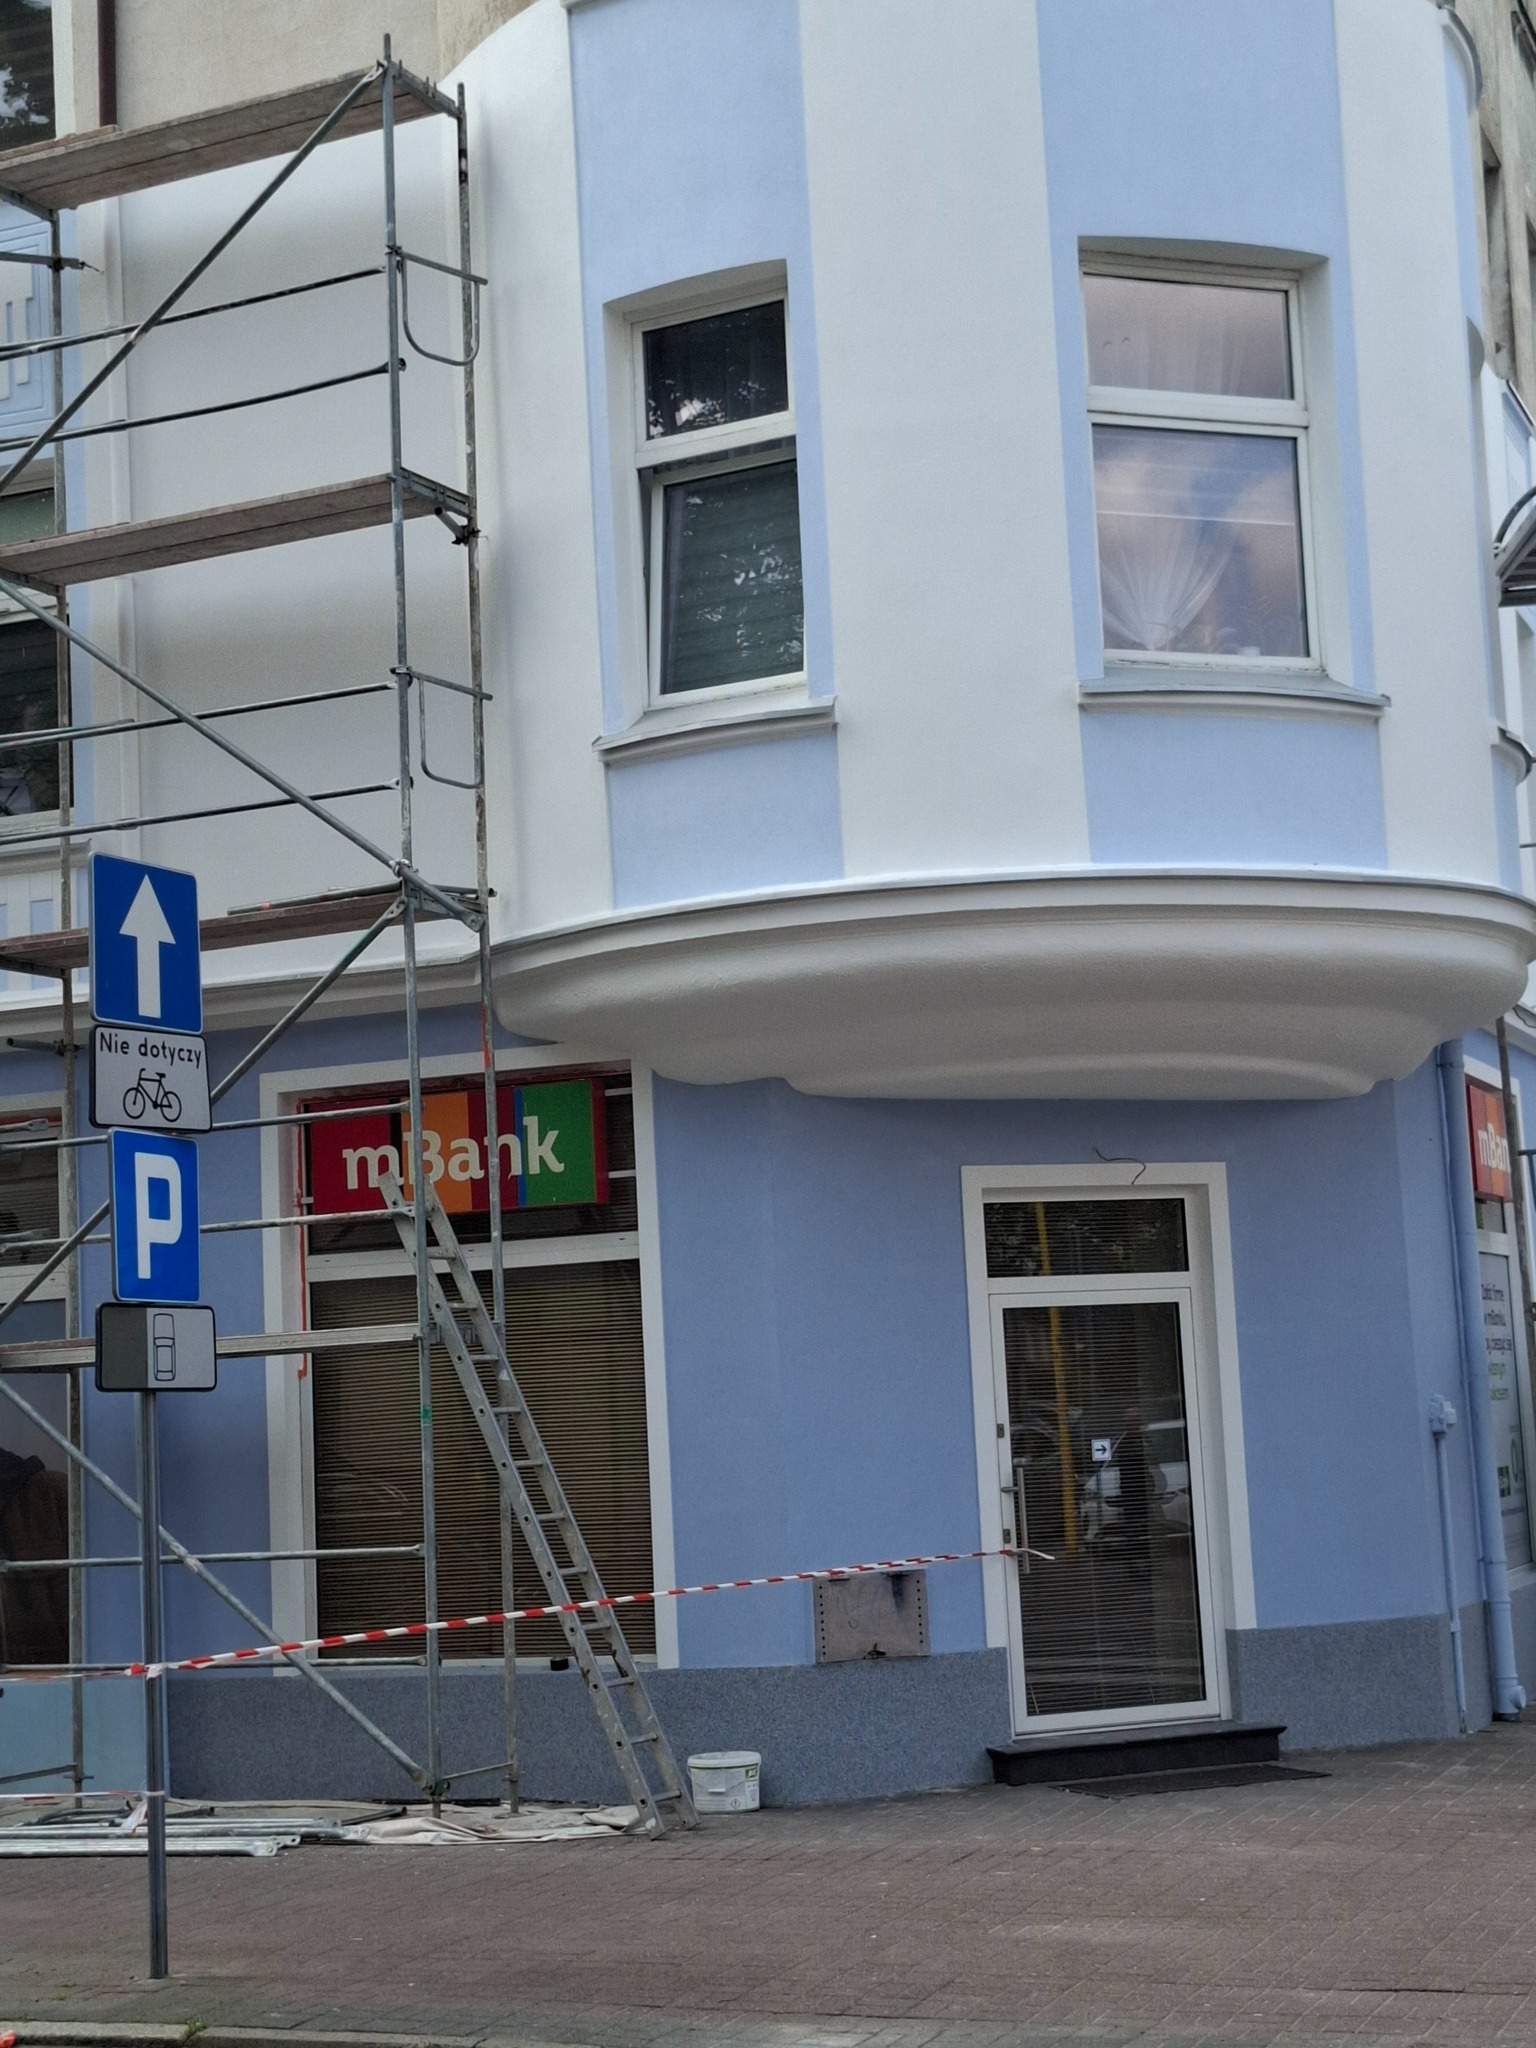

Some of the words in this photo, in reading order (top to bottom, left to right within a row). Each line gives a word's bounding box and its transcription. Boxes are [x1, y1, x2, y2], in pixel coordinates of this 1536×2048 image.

[100, 1032, 130, 1055] Nie
[138, 1037, 201, 1069] dotyczy
[342, 1116, 565, 1190] mBank
[1477, 1122, 1512, 1173] mBan
[134, 1151, 182, 1279] P
